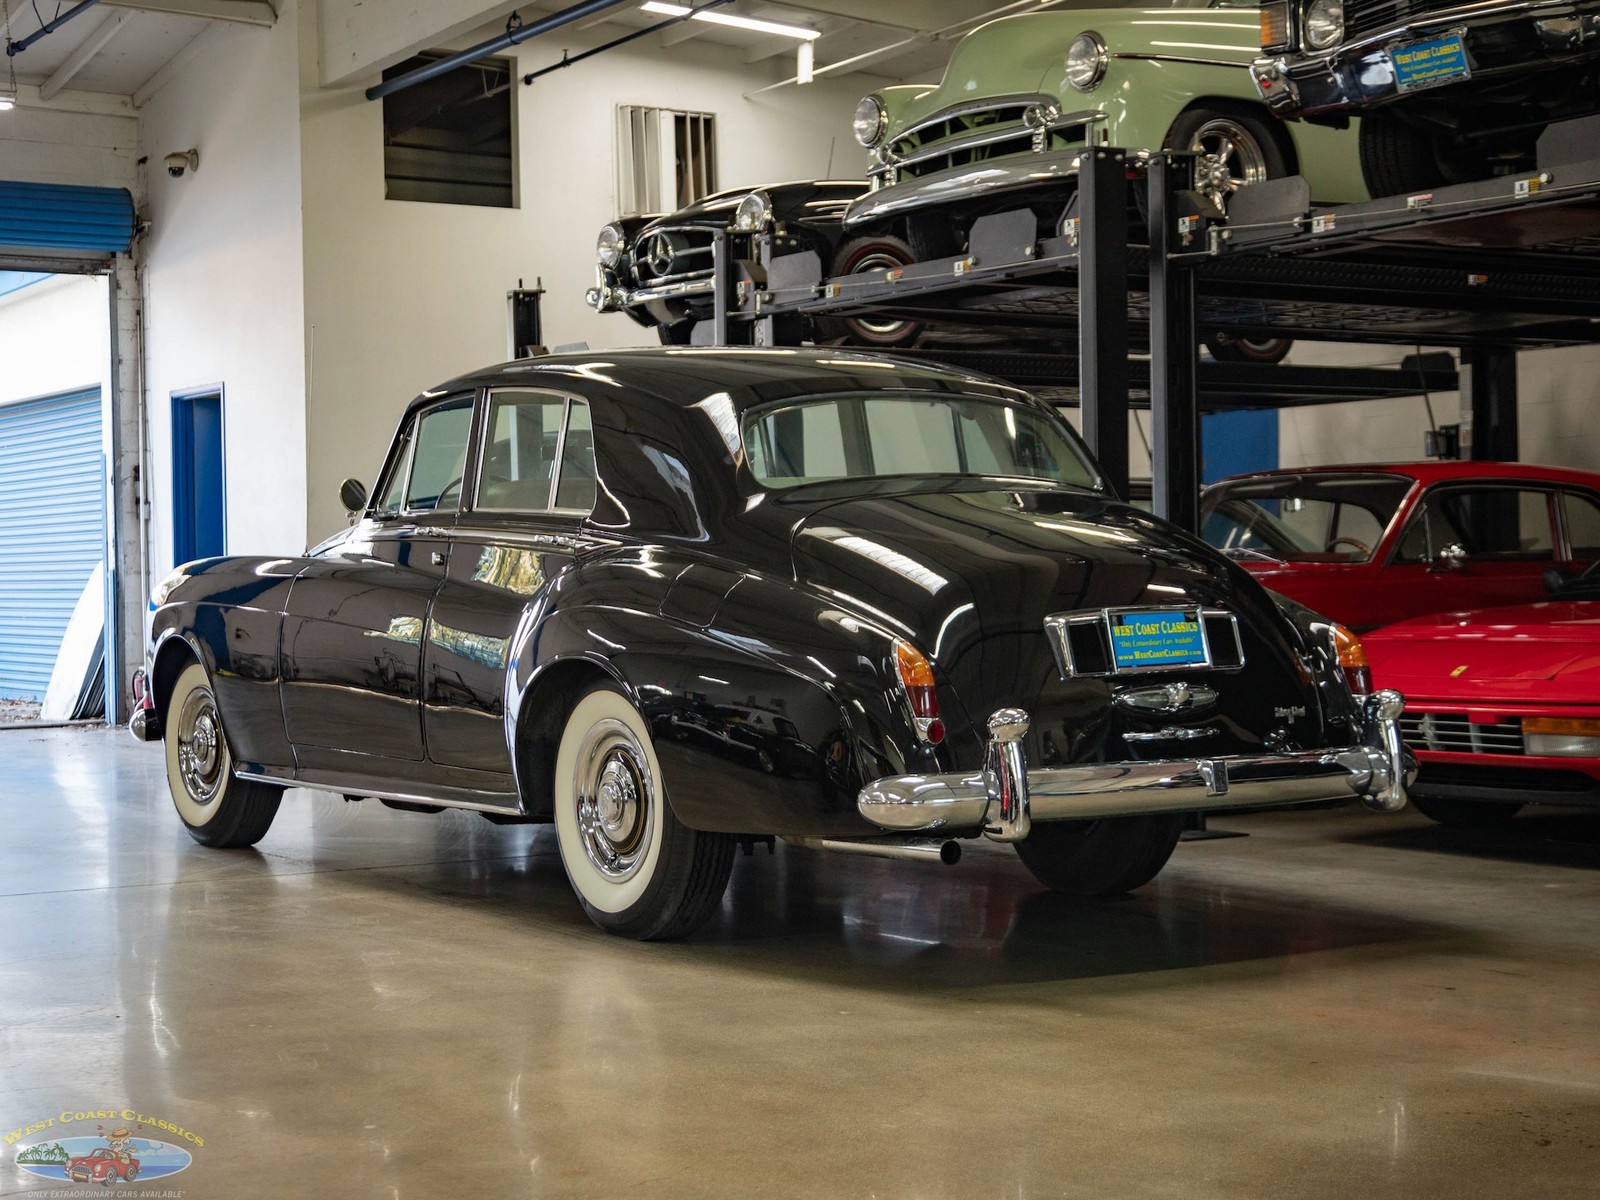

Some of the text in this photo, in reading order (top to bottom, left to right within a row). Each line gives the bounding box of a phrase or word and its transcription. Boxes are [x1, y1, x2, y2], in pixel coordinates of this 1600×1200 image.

[1113, 621, 1198, 636] WEST COAST CLASSICS
